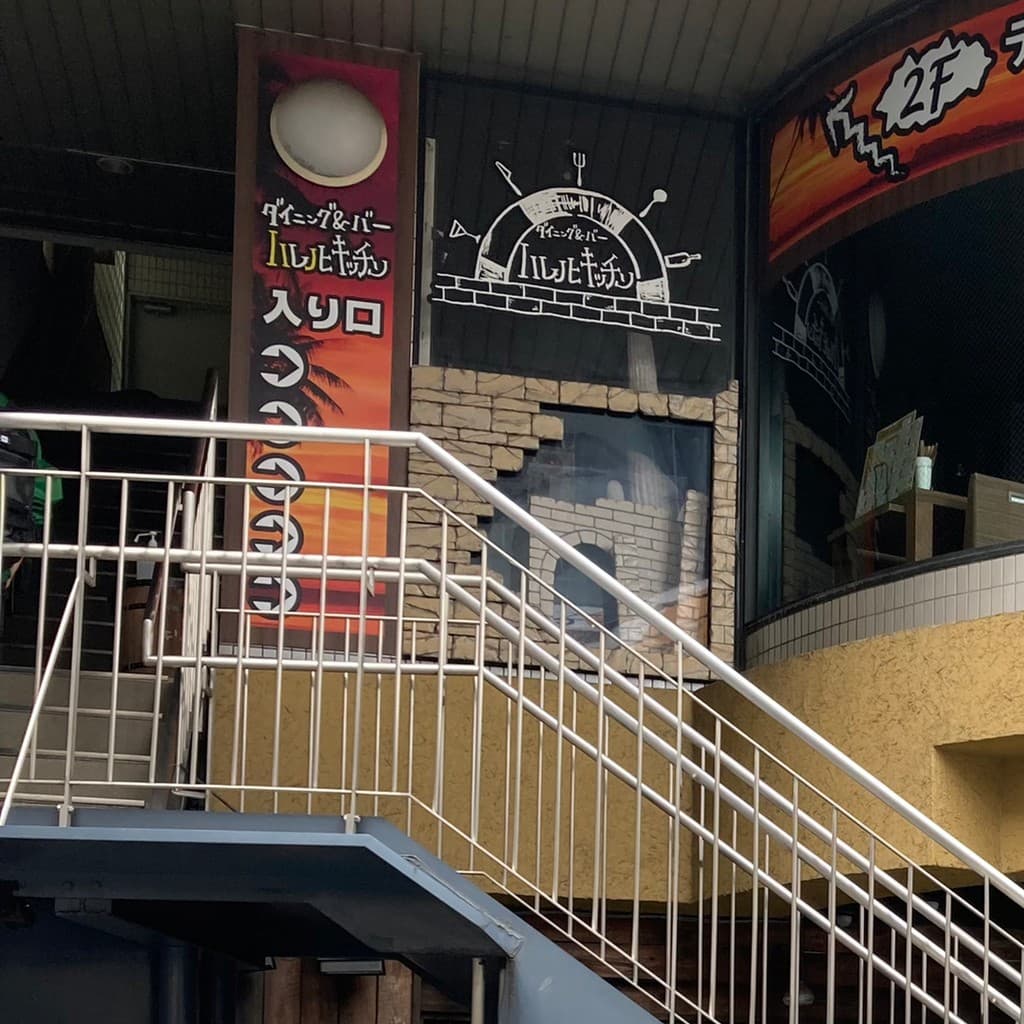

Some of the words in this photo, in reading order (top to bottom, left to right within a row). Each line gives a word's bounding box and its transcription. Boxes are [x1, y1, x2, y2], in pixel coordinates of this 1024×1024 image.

[899, 49, 963, 117] 2F
[263, 289, 381, 335] 入り口
